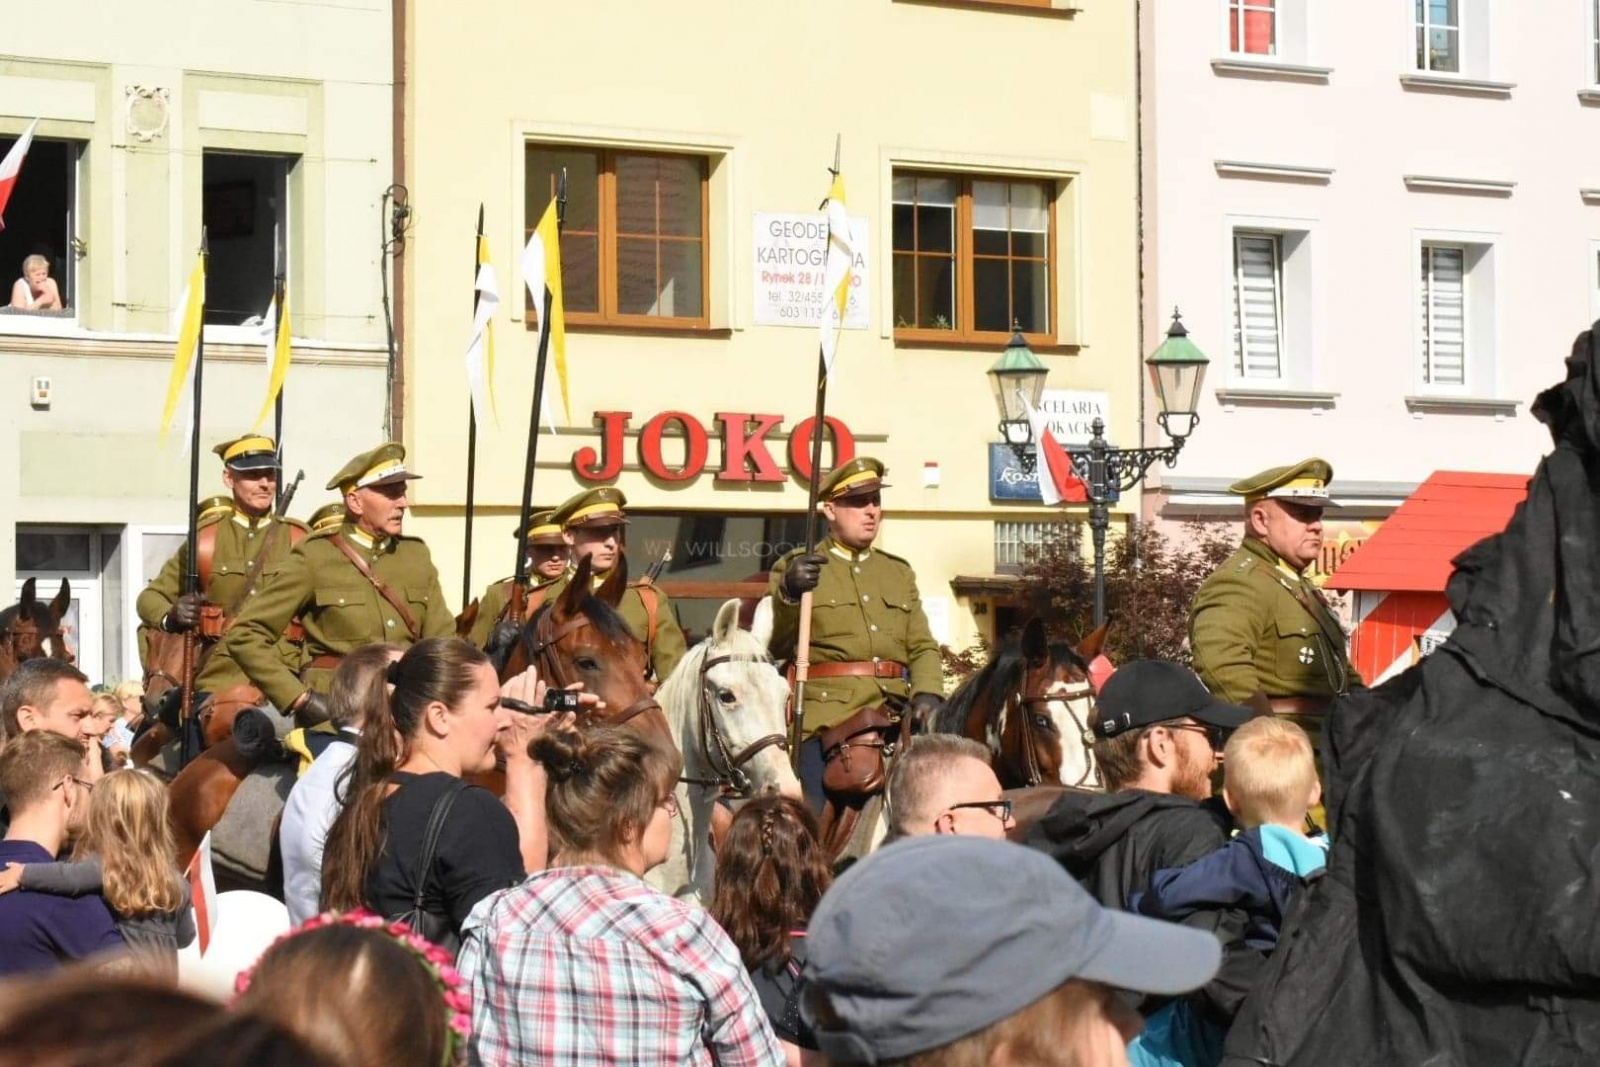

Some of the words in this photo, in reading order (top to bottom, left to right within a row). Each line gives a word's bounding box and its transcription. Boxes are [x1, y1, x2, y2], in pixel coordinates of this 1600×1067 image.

[761, 270, 795, 285] Rynek
[798, 272, 812, 285] 28
[572, 410, 856, 482] JOKO
